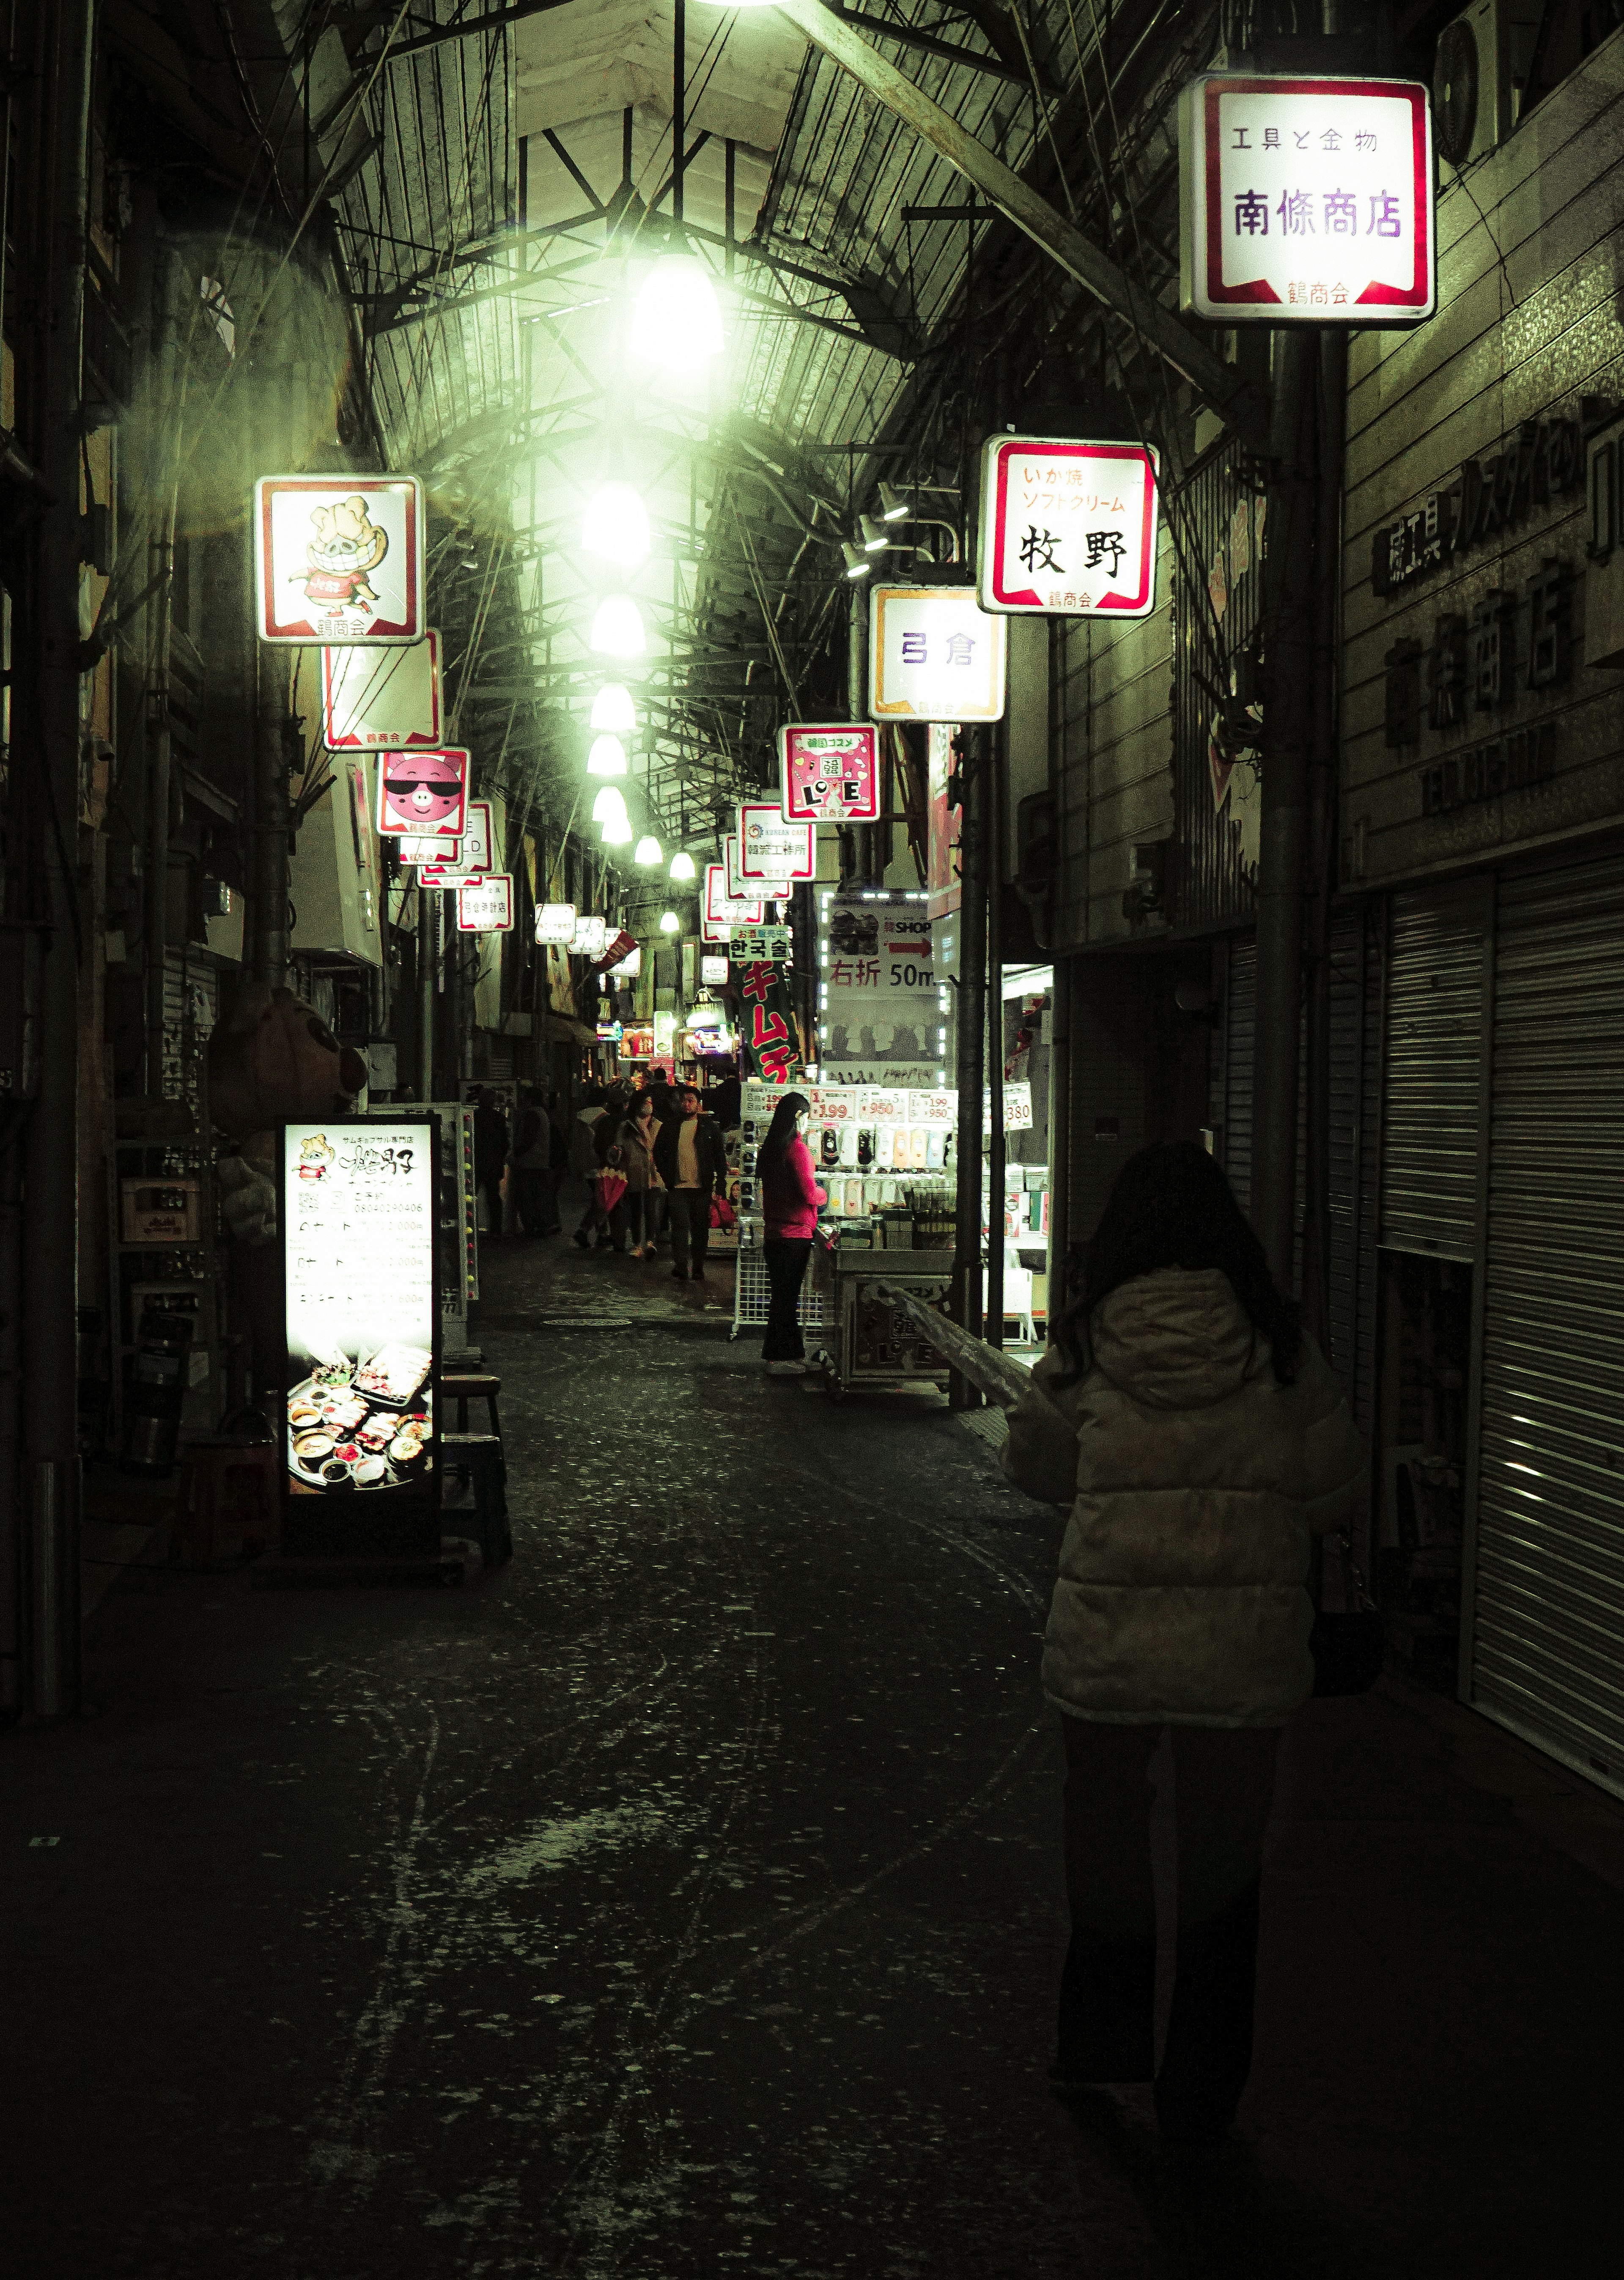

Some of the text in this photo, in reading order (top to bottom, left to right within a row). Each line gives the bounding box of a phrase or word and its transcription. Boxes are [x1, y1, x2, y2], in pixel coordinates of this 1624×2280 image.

[1232, 128, 1377, 151] 工具と金物
[1234, 188, 1402, 238] 南條商店
[1287, 281, 1349, 305] 鶴商会
[1024, 468, 1083, 486] いか焼
[1024, 493, 1125, 512] ソフトクリーム
[1019, 524, 1127, 578] 牧野
[1048, 592, 1093, 608] 鶴商会
[318, 619, 365, 636] 鶴商会
[903, 633, 976, 665] 弓倉
[918, 700, 955, 714] 鶴商会
[366, 733, 400, 743] 鶴商会
[820, 809, 845, 818] 鶴商会
[730, 938, 787, 958] 한국술
[830, 959, 934, 987] 右折 50m
[743, 960, 799, 1084] キムチ
[1007, 1105, 1029, 1120] 380
